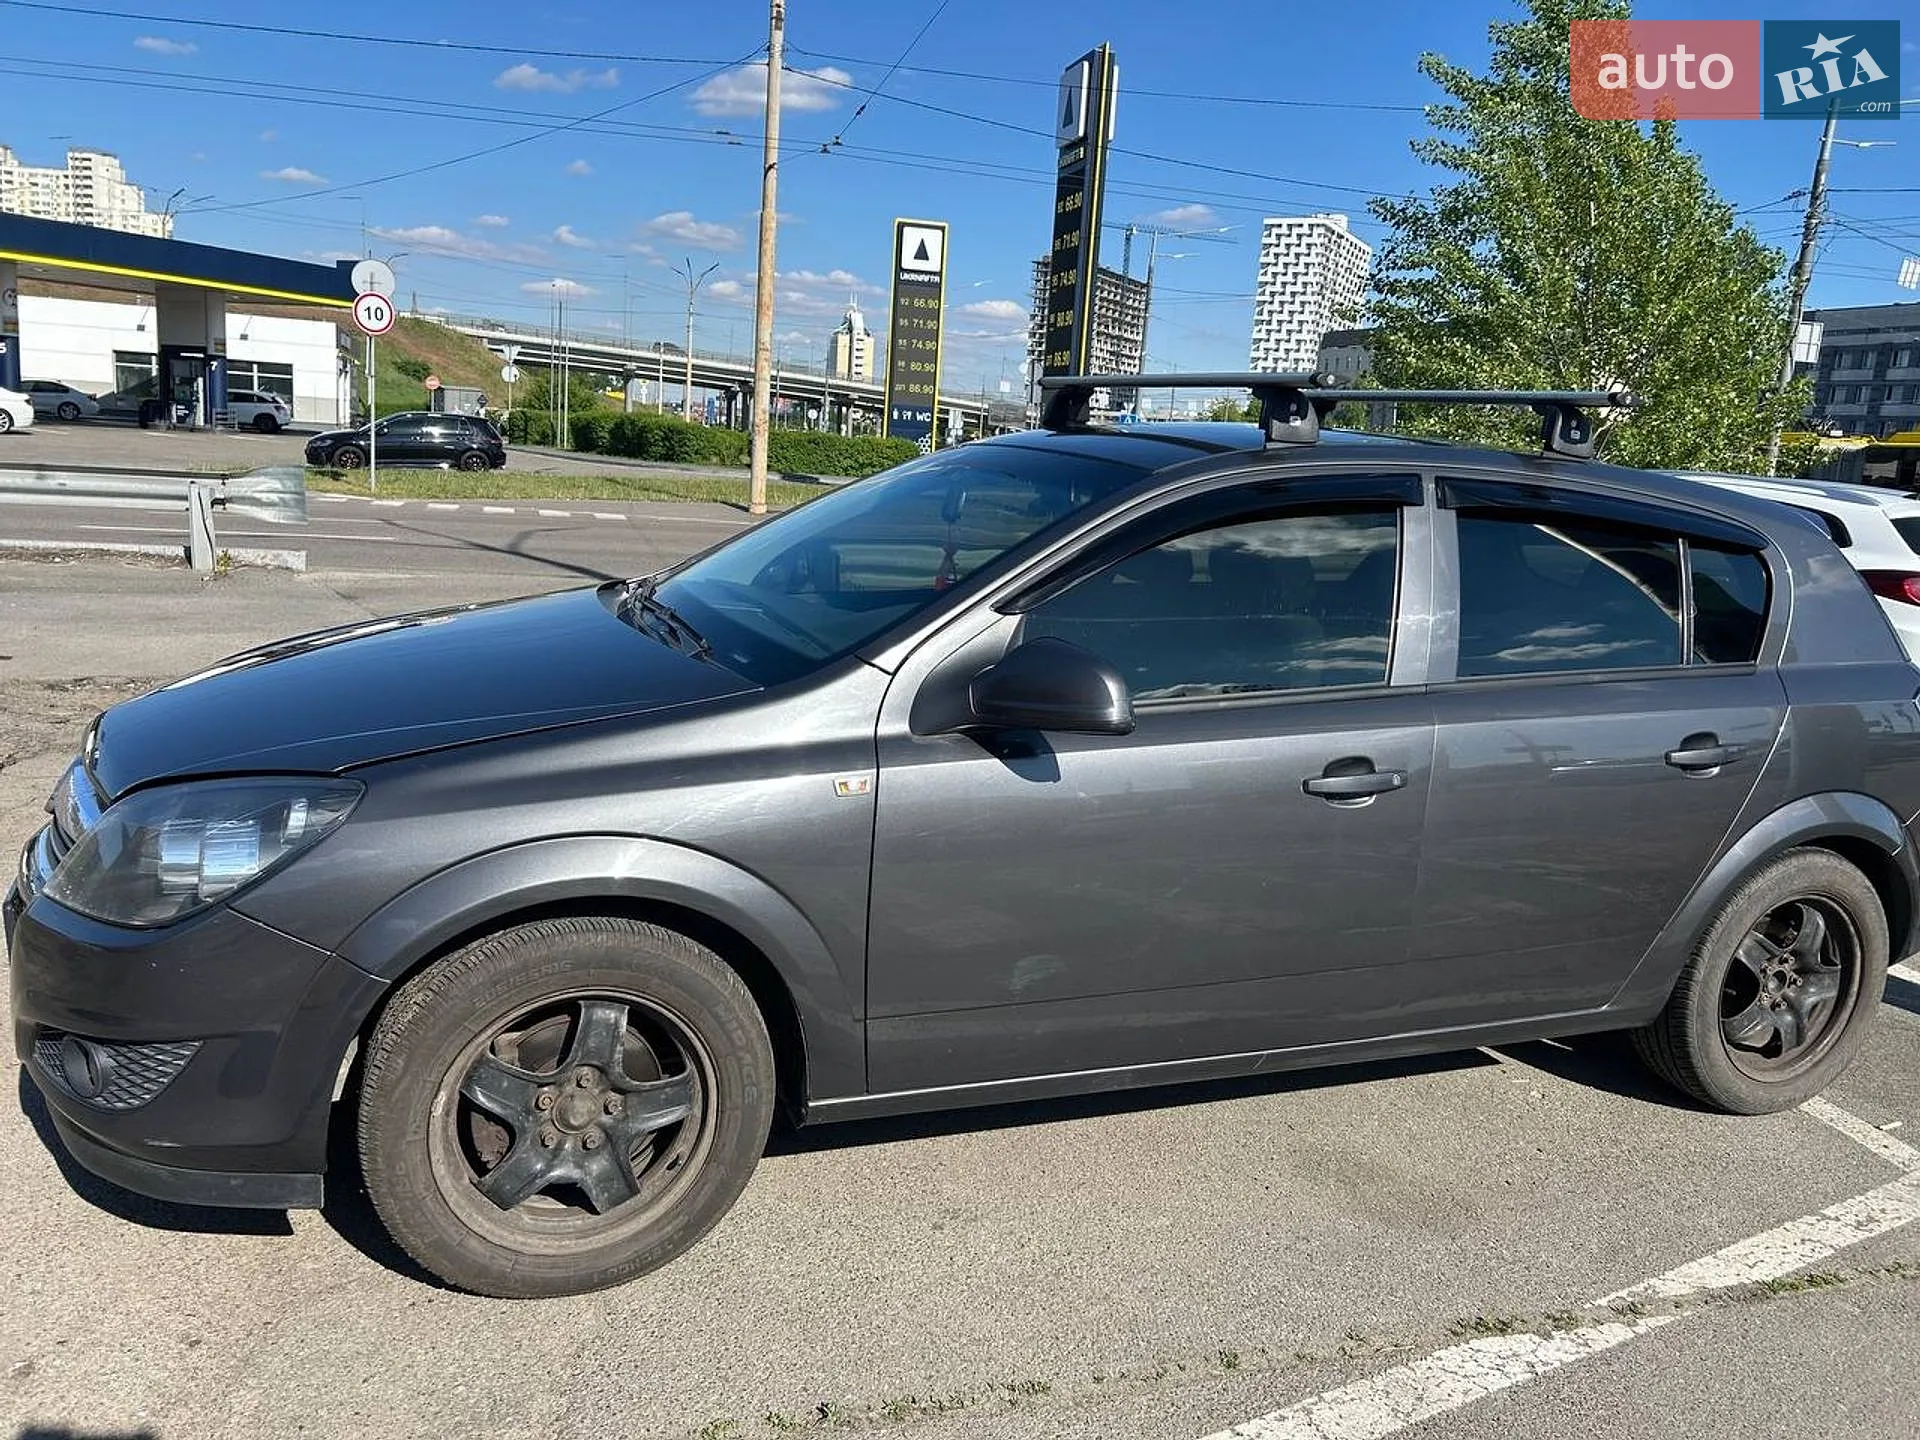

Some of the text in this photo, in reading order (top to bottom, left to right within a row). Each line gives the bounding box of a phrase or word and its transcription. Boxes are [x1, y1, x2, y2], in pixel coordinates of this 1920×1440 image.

[914, 299, 938, 309] 66.90
[364, 306, 384, 322] 10
[913, 319, 937, 329] 71.90
[911, 339, 936, 350] 74.90
[210, 361, 218, 371] 7
[910, 361, 935, 372] 80.90
[908, 384, 934, 394] 86.90
[916, 412, 931, 422] WC
